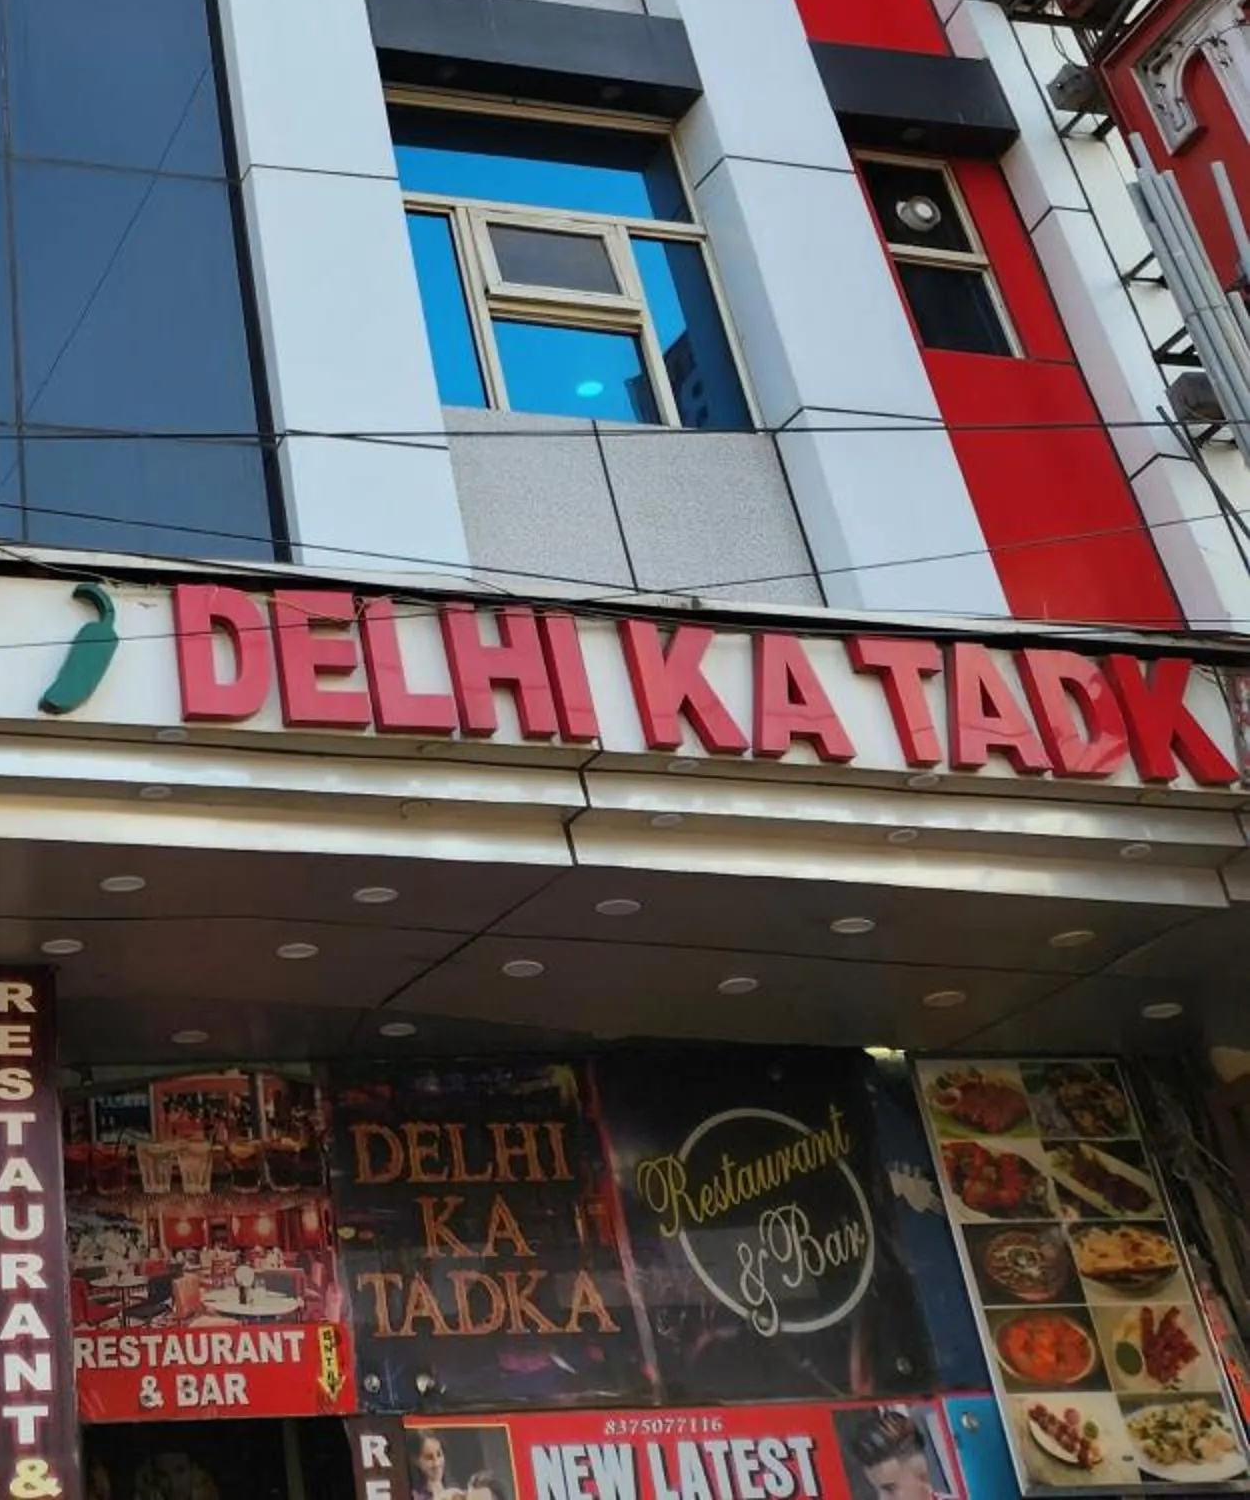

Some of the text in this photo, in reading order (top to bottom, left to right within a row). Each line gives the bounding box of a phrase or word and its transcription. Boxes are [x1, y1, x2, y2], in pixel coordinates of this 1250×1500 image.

[172, 584, 1240, 786] DELHI KA TADK
[348, 1121, 574, 1184] DELHI
[636, 1103, 852, 1238] Restaurant
[413, 1190, 537, 1257] KA
[736, 1202, 869, 1338] & Bar
[357, 1268, 621, 1337] TADKA
[74, 1331, 305, 1369] RESTAURANT
[139, 1373, 250, 1408] & BAR
[603, 1416, 724, 1436] 8375077116
[8, 1458, 62, 1500] &
[530, 1437, 822, 1500] NEW LATEST
